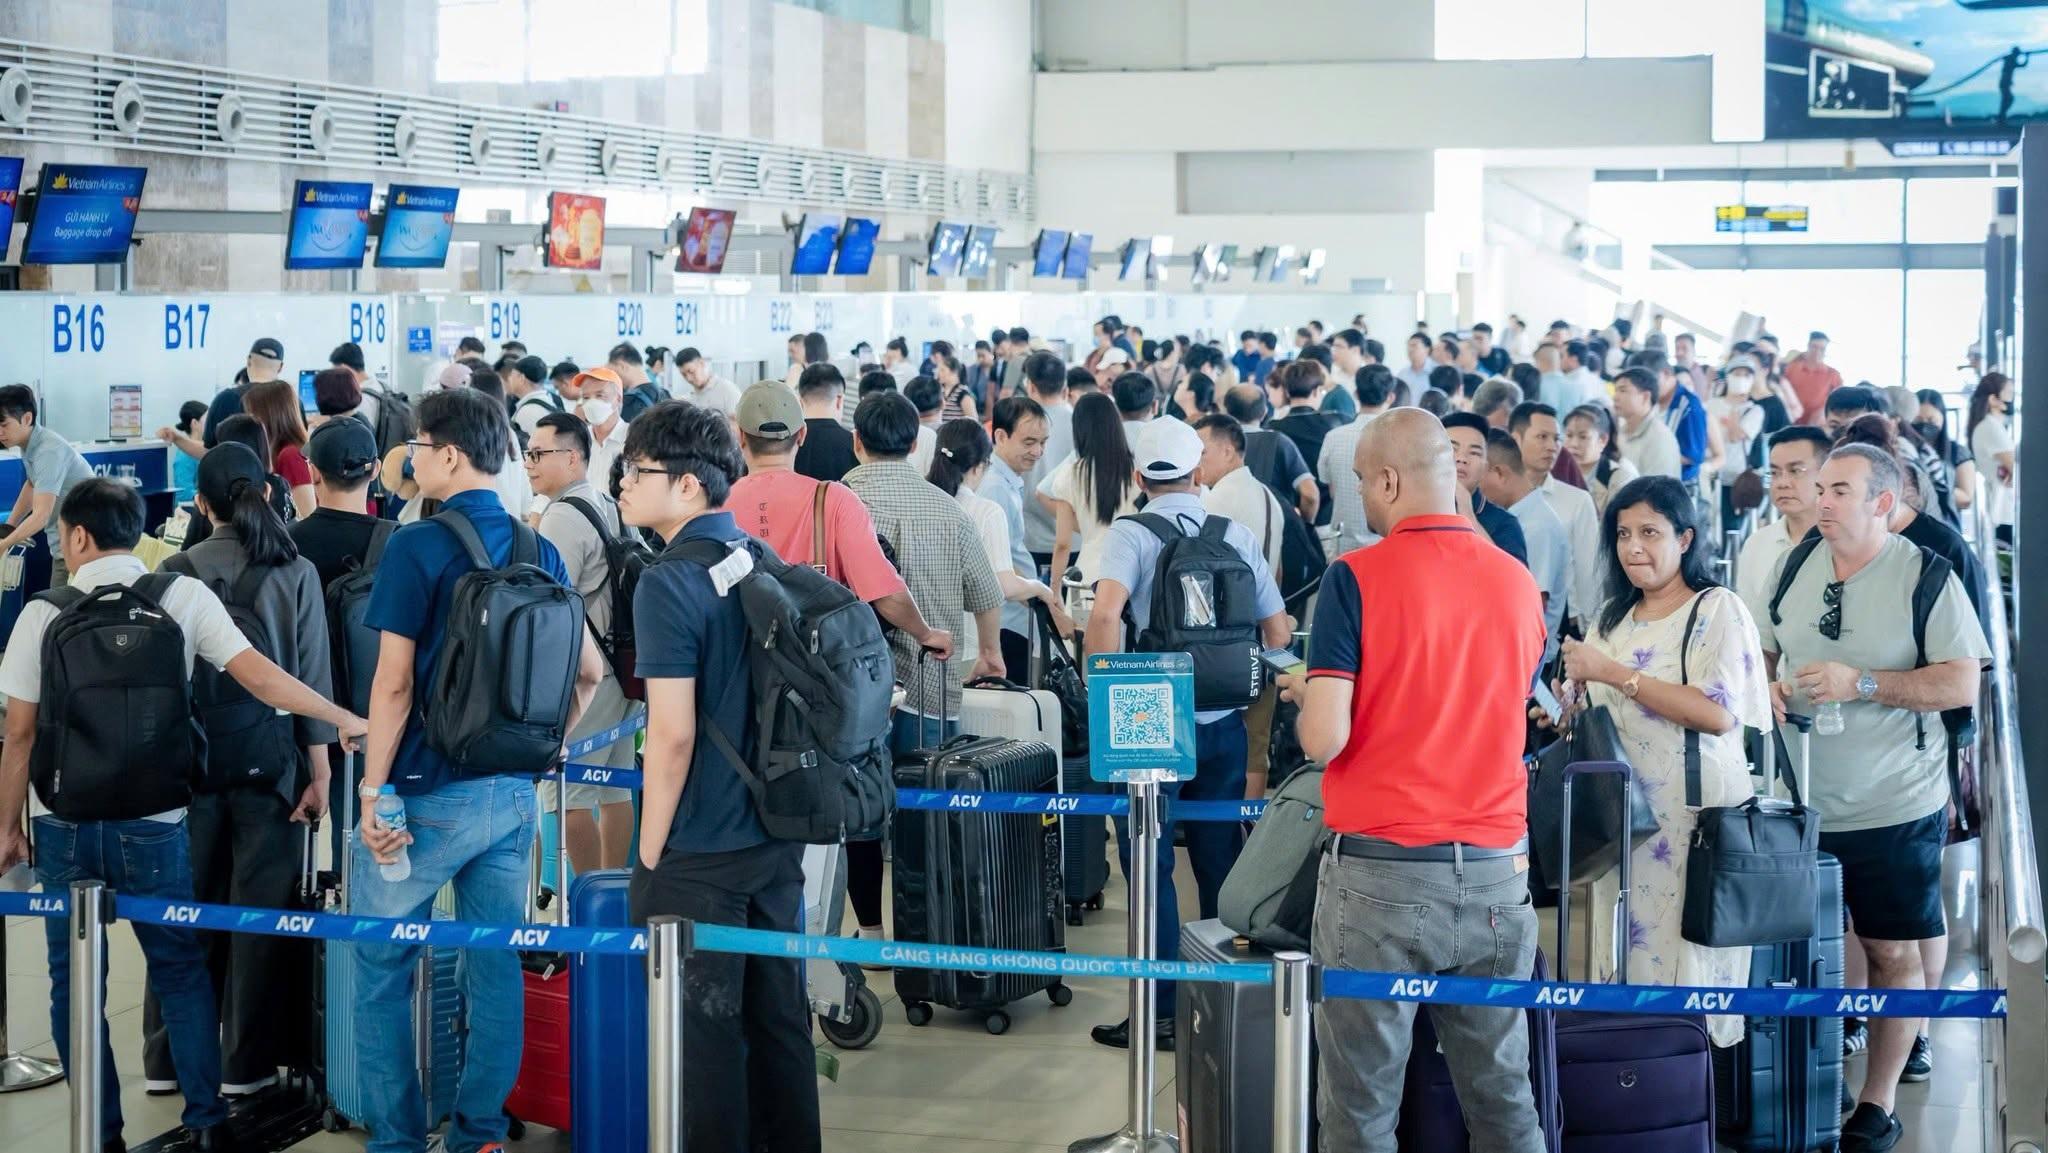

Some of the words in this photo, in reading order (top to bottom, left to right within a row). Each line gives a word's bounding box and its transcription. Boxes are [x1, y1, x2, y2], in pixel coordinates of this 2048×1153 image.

[54, 226, 84, 240] Baggage
[85, 226, 102, 239] drop
[102, 226, 113, 237] off
[54, 304, 105, 353] B16
[165, 304, 210, 350] B17
[351, 303, 385, 343] B18
[491, 302, 521, 339] B19
[618, 302, 643, 336] B20
[675, 302, 698, 334] B21
[1110, 660, 1144, 669] Vietnam
[1144, 660, 1175, 669] Airlines
[1249, 646, 1259, 697] STRIVE
[582, 768, 612, 783] ACV
[948, 794, 982, 809] ACV
[1046, 797, 1080, 811] ACV
[29, 898, 64, 912] N.I.A
[162, 905, 201, 923] ACV
[275, 914, 316, 933] ACV
[390, 923, 432, 941] ACV
[508, 928, 551, 946] ACV
[1389, 978, 1438, 998] ACV
[1535, 986, 1585, 1006] ACV
[1684, 992, 1735, 1011] ACV
[1836, 994, 1888, 1013] ACV
